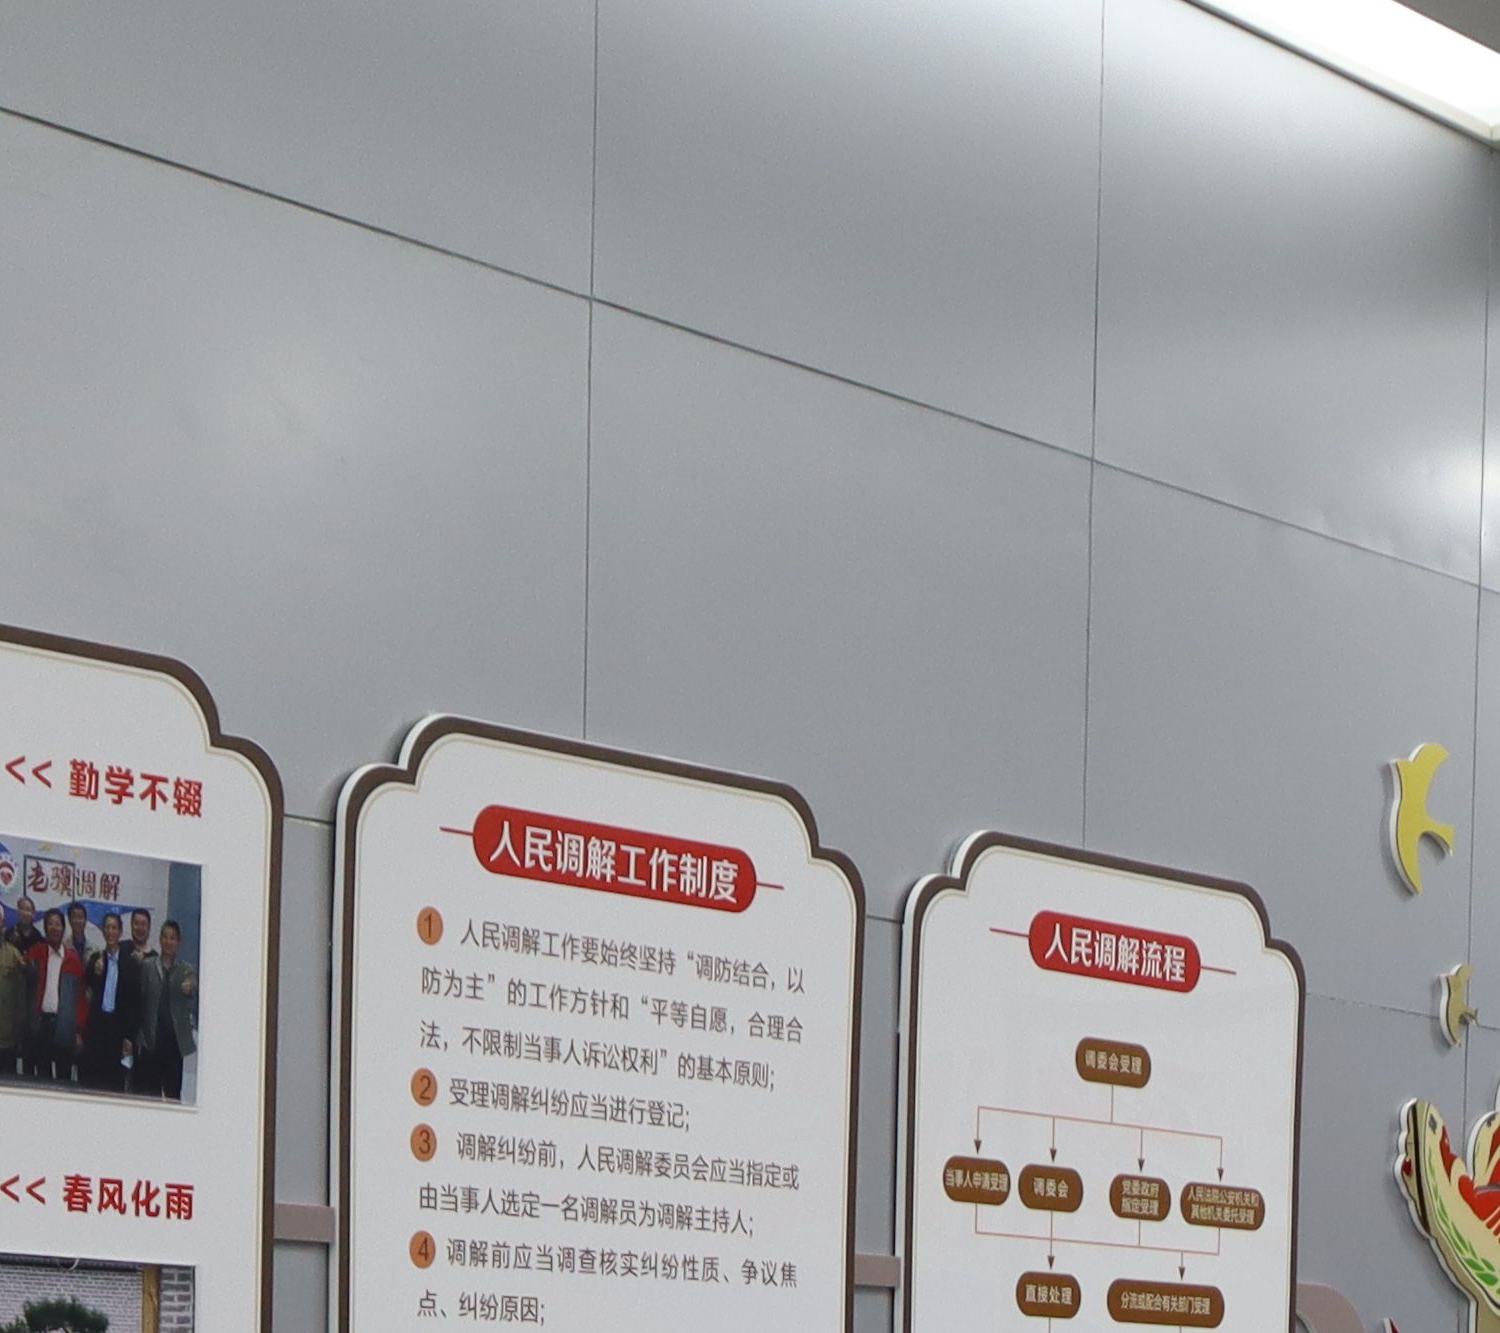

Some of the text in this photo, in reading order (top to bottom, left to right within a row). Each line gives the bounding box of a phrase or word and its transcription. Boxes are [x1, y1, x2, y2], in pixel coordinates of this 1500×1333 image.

[69, 759, 203, 818] 勤学不辍
[489, 821, 739, 903] 人民调解工作制度
[1045, 923, 1186, 983] 人民调解流程
[1085, 1049, 1142, 1075] 调委会受理
[62, 1175, 195, 1219] 春风化雨
[1034, 1178, 1068, 1198] 调委会
[1025, 1284, 1072, 1305] 直接处理
